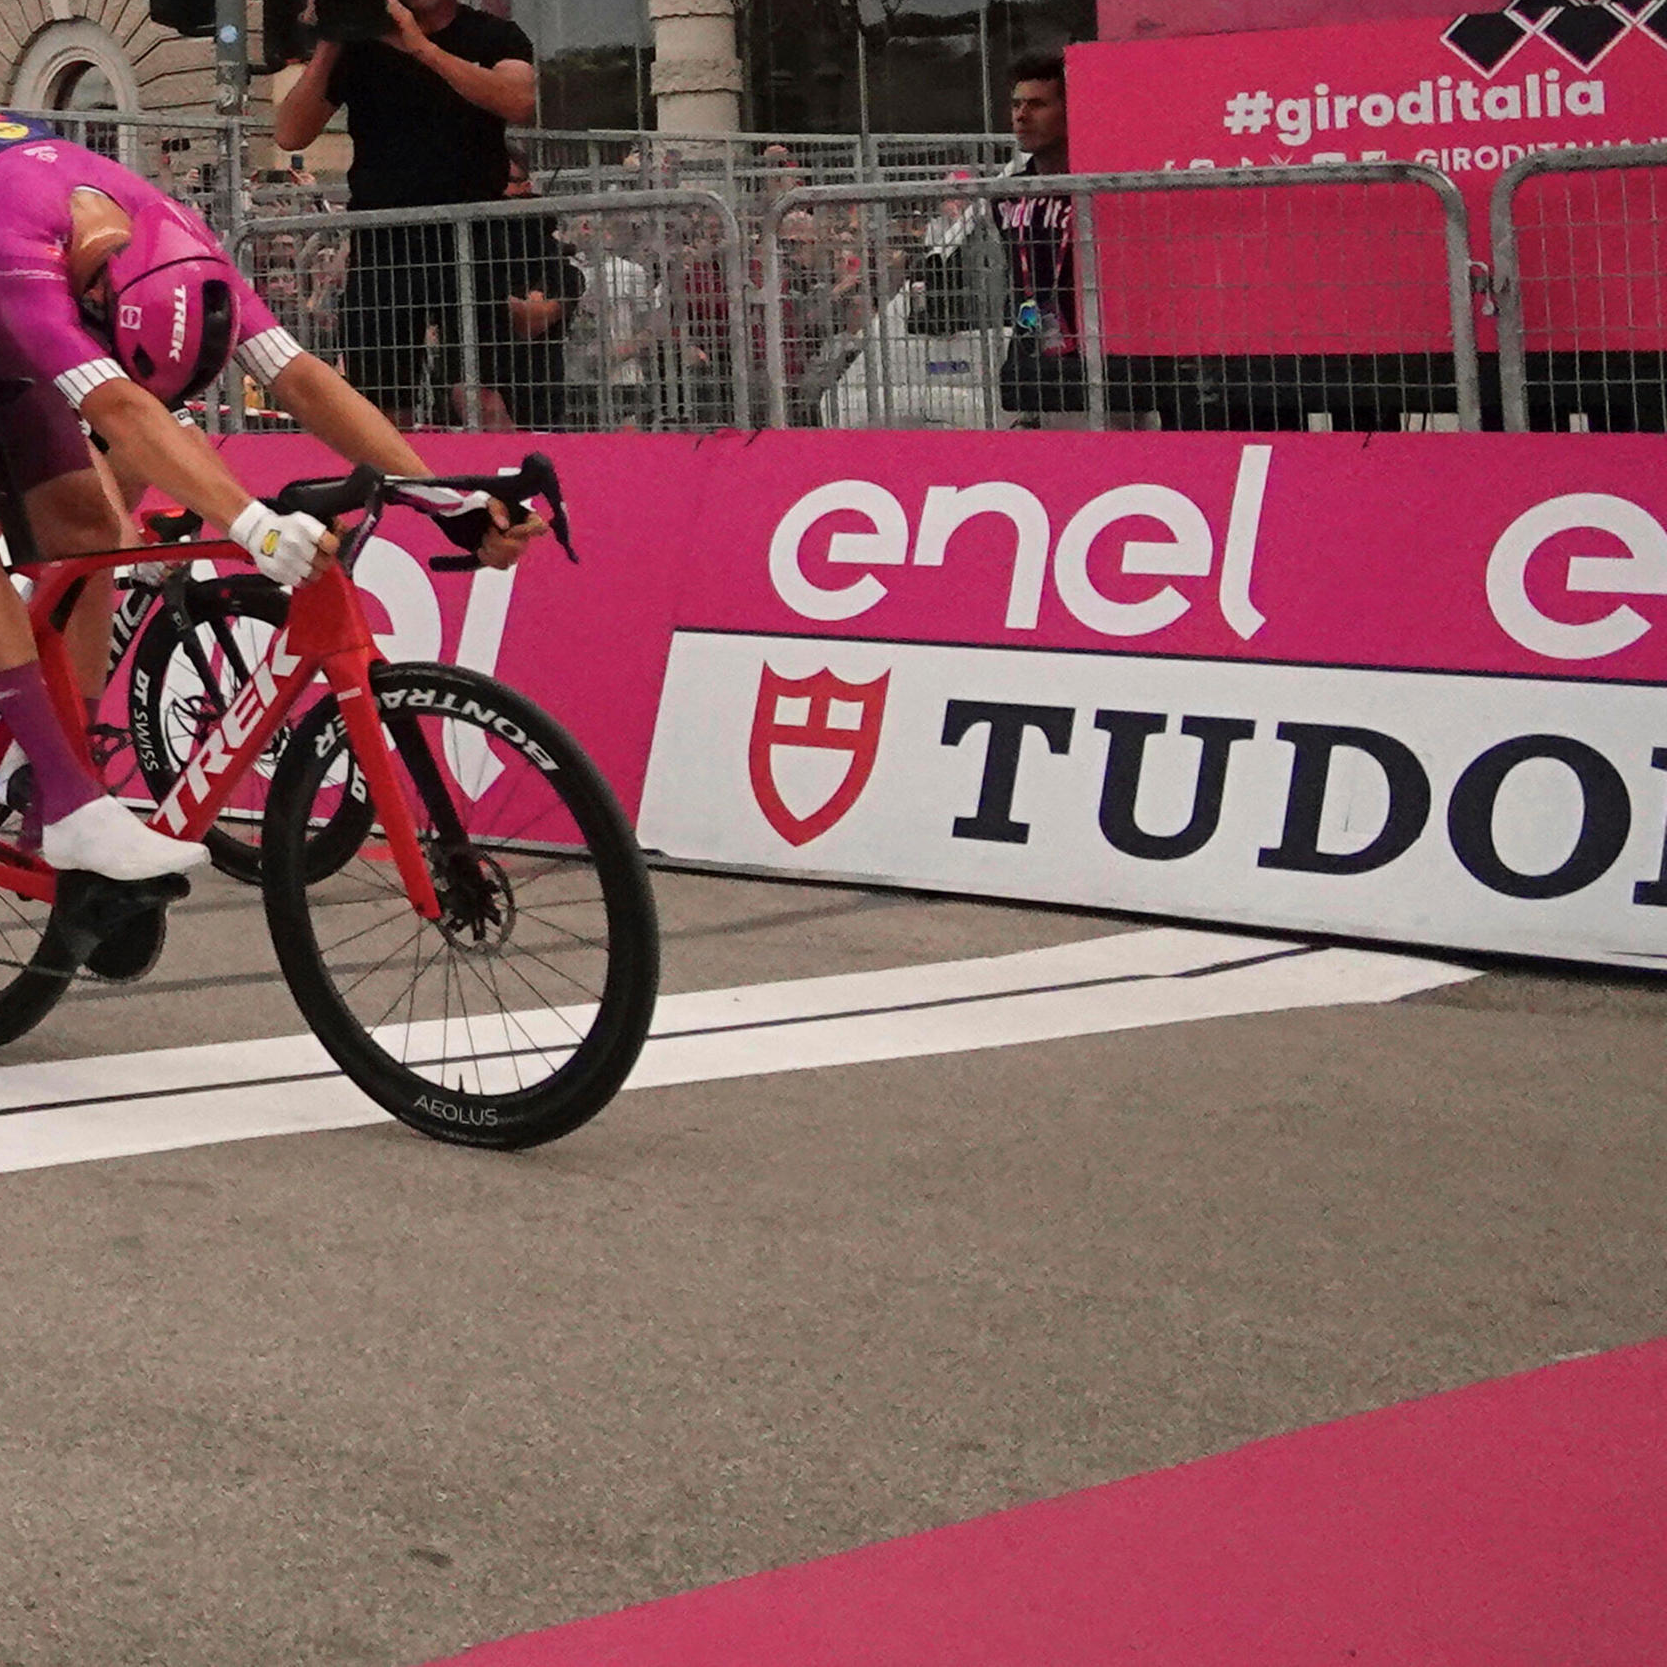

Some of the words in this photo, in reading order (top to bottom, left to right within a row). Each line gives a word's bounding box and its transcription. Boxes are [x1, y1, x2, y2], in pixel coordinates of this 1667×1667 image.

[1223, 67, 1606, 147] #giroditalia
[168, 283, 188, 364] TREK
[768, 444, 1274, 641] enel
[132, 707, 159, 773] SWISS
[152, 627, 304, 836] TREK
[939, 697, 1667, 908] TUDO
[412, 1092, 500, 1128] AEOLUS
